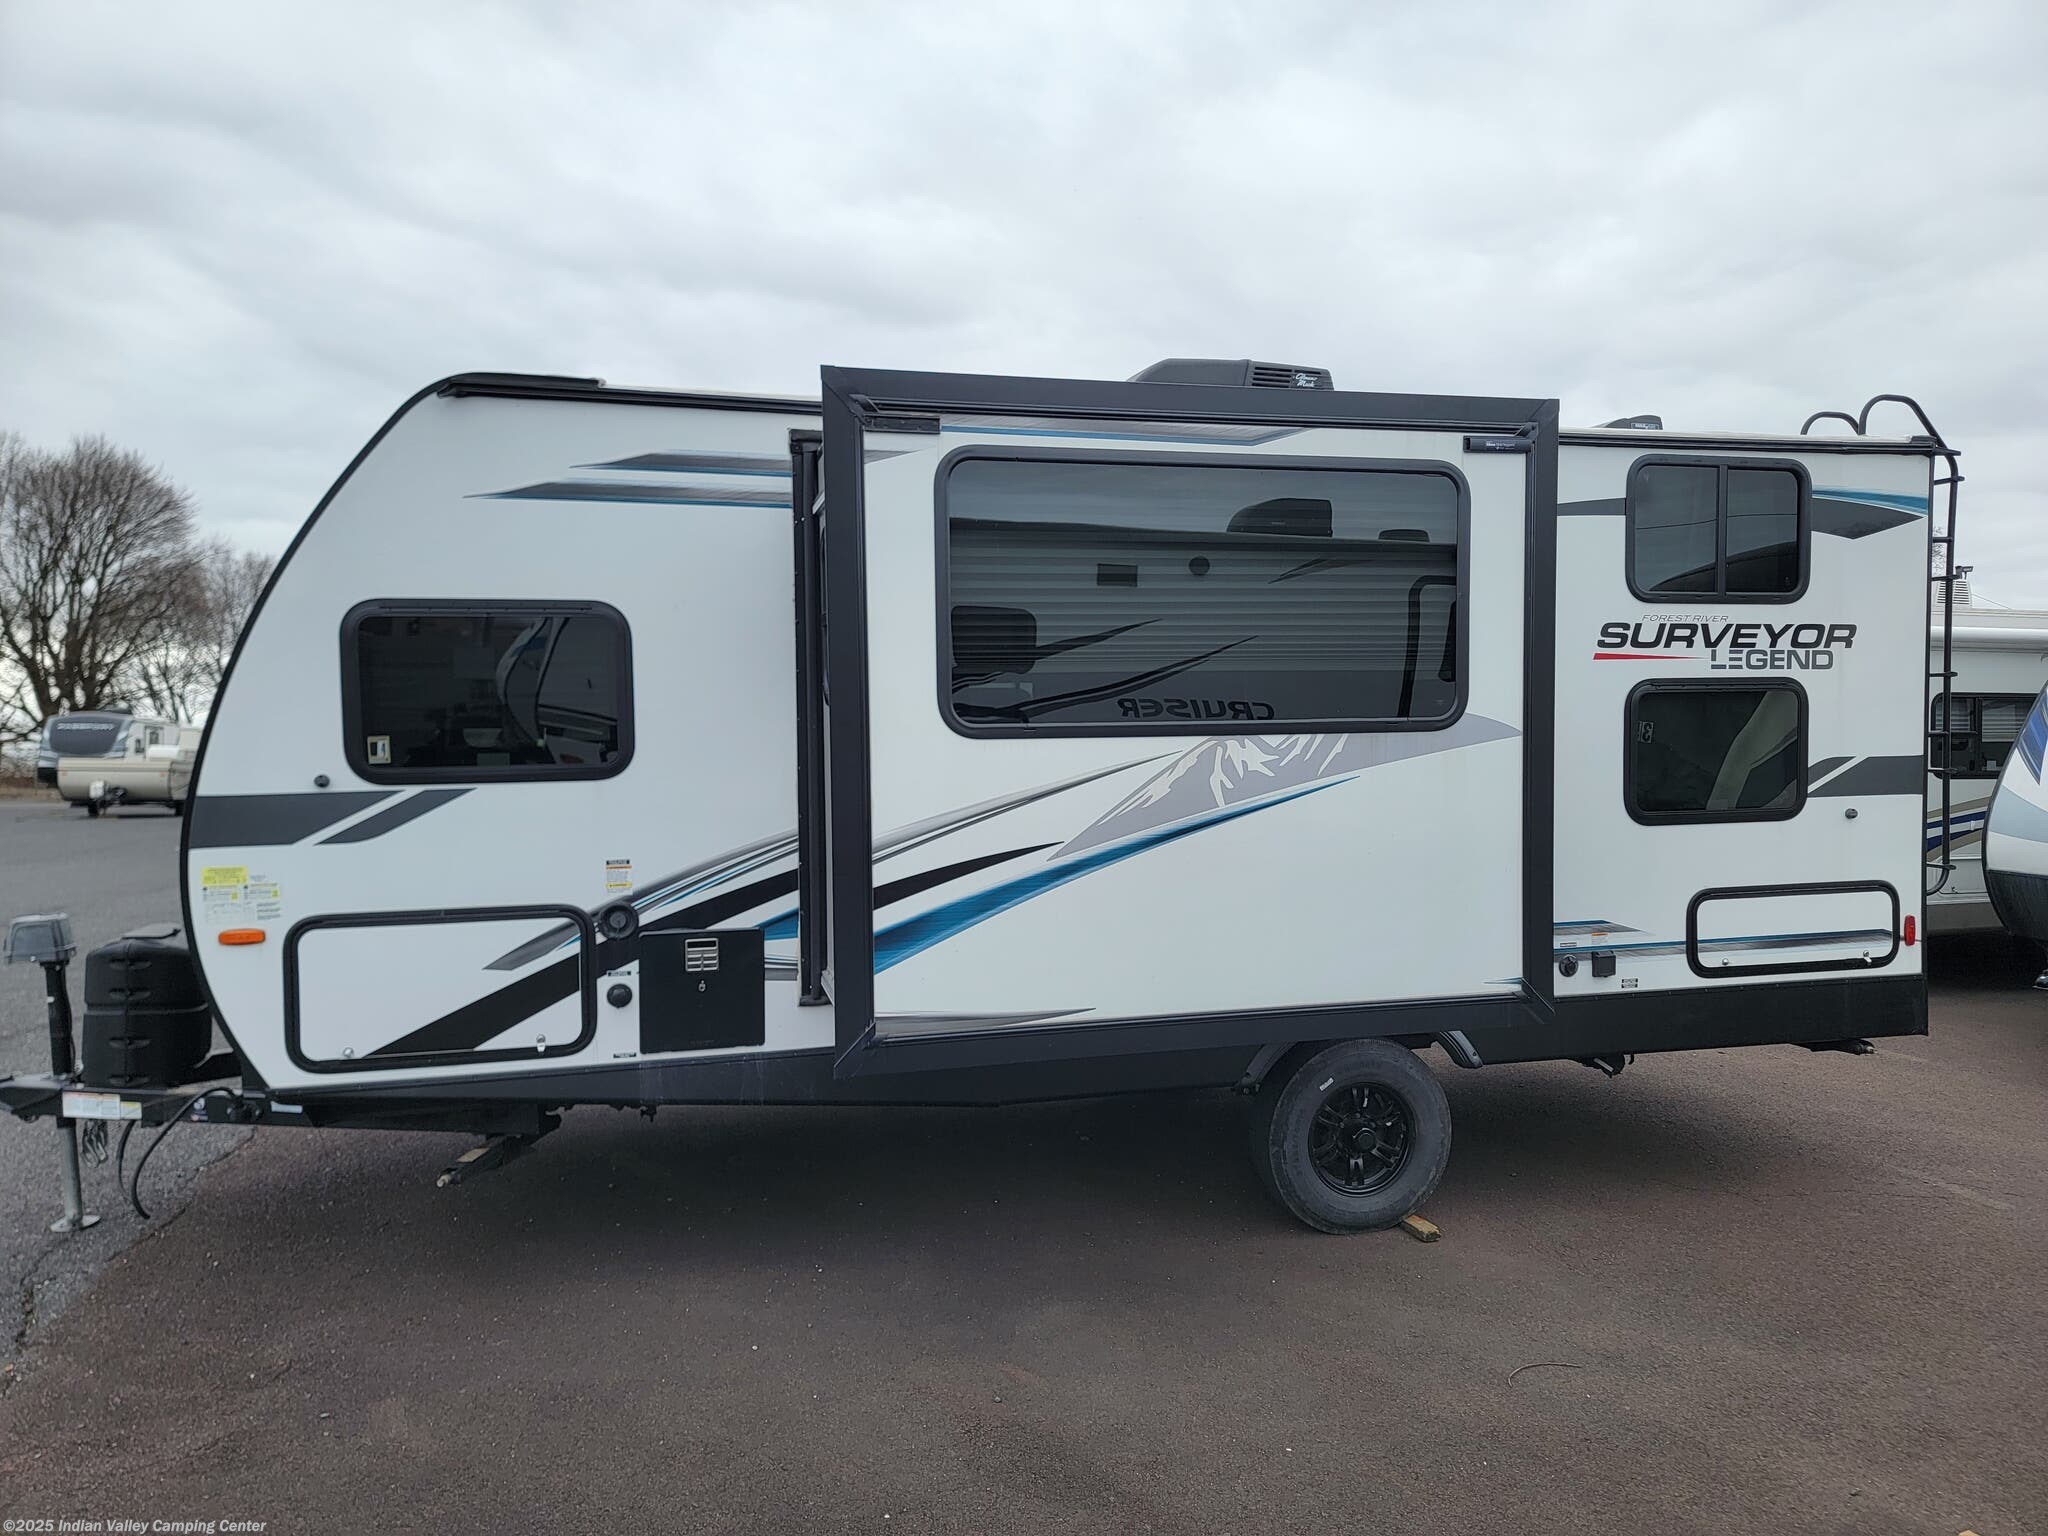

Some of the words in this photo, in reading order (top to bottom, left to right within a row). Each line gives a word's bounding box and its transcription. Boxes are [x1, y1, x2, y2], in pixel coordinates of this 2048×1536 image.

[1641, 614, 1692, 623] FOREST
[1693, 615, 1729, 623] RIVER
[1597, 622, 1857, 649] SURVEYOR
[1710, 649, 1834, 670] LEGEND
